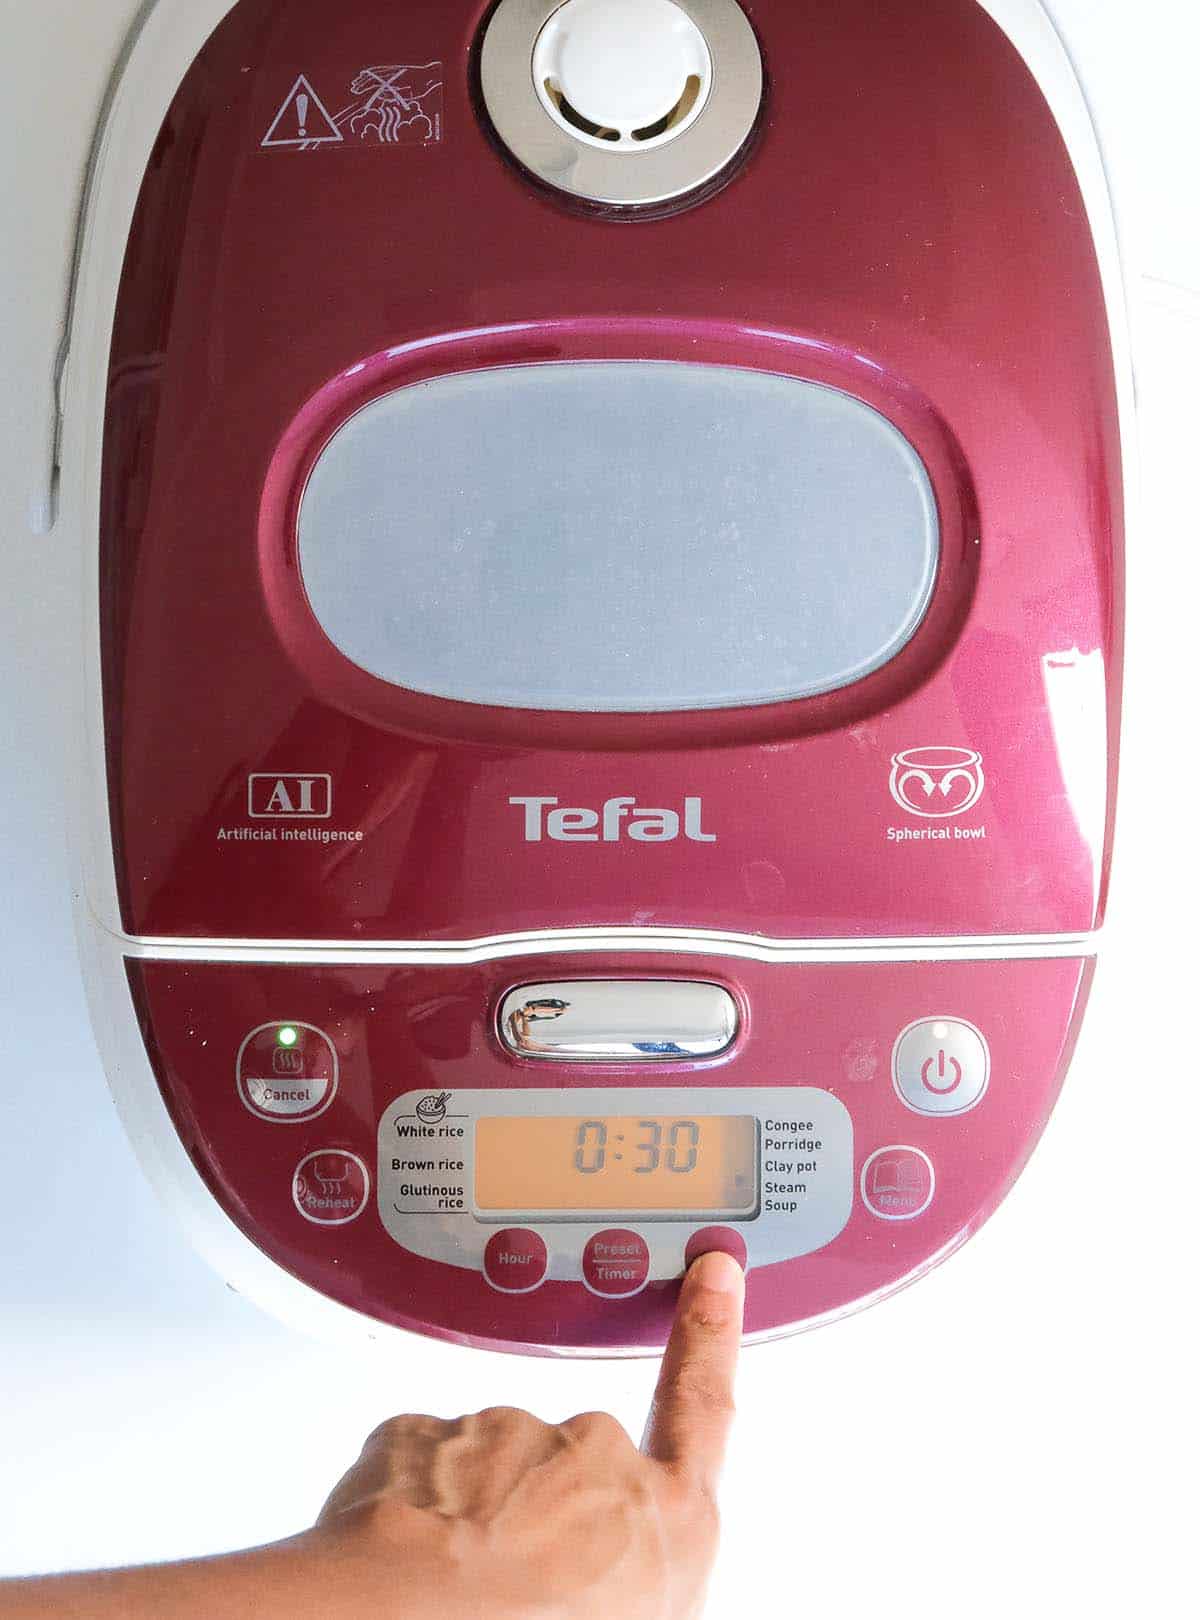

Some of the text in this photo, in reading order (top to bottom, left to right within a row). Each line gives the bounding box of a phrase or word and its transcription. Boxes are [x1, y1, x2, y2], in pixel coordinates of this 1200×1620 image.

[265, 779, 317, 813] AI
[509, 797, 717, 842] Tefal
[216, 827, 364, 845] Artificial intelligence
[887, 825, 986, 843] Spherical bowl
[263, 1088, 310, 1102] Cancel
[396, 1125, 464, 1138] White rice
[764, 1119, 814, 1134] Congee
[573, 1120, 700, 1174] 0:30
[764, 1138, 822, 1153] Porridge
[391, 1158, 464, 1171] Brown rice
[764, 1160, 817, 1175] Clay pot
[399, 1184, 464, 1197] Glutinous
[764, 1181, 807, 1194] Steam
[306, 1196, 355, 1210] Reheat
[437, 1197, 464, 1209] rice
[764, 1199, 798, 1213] Soup
[498, 1252, 534, 1266] Hour
[595, 1267, 639, 1281] Timer
